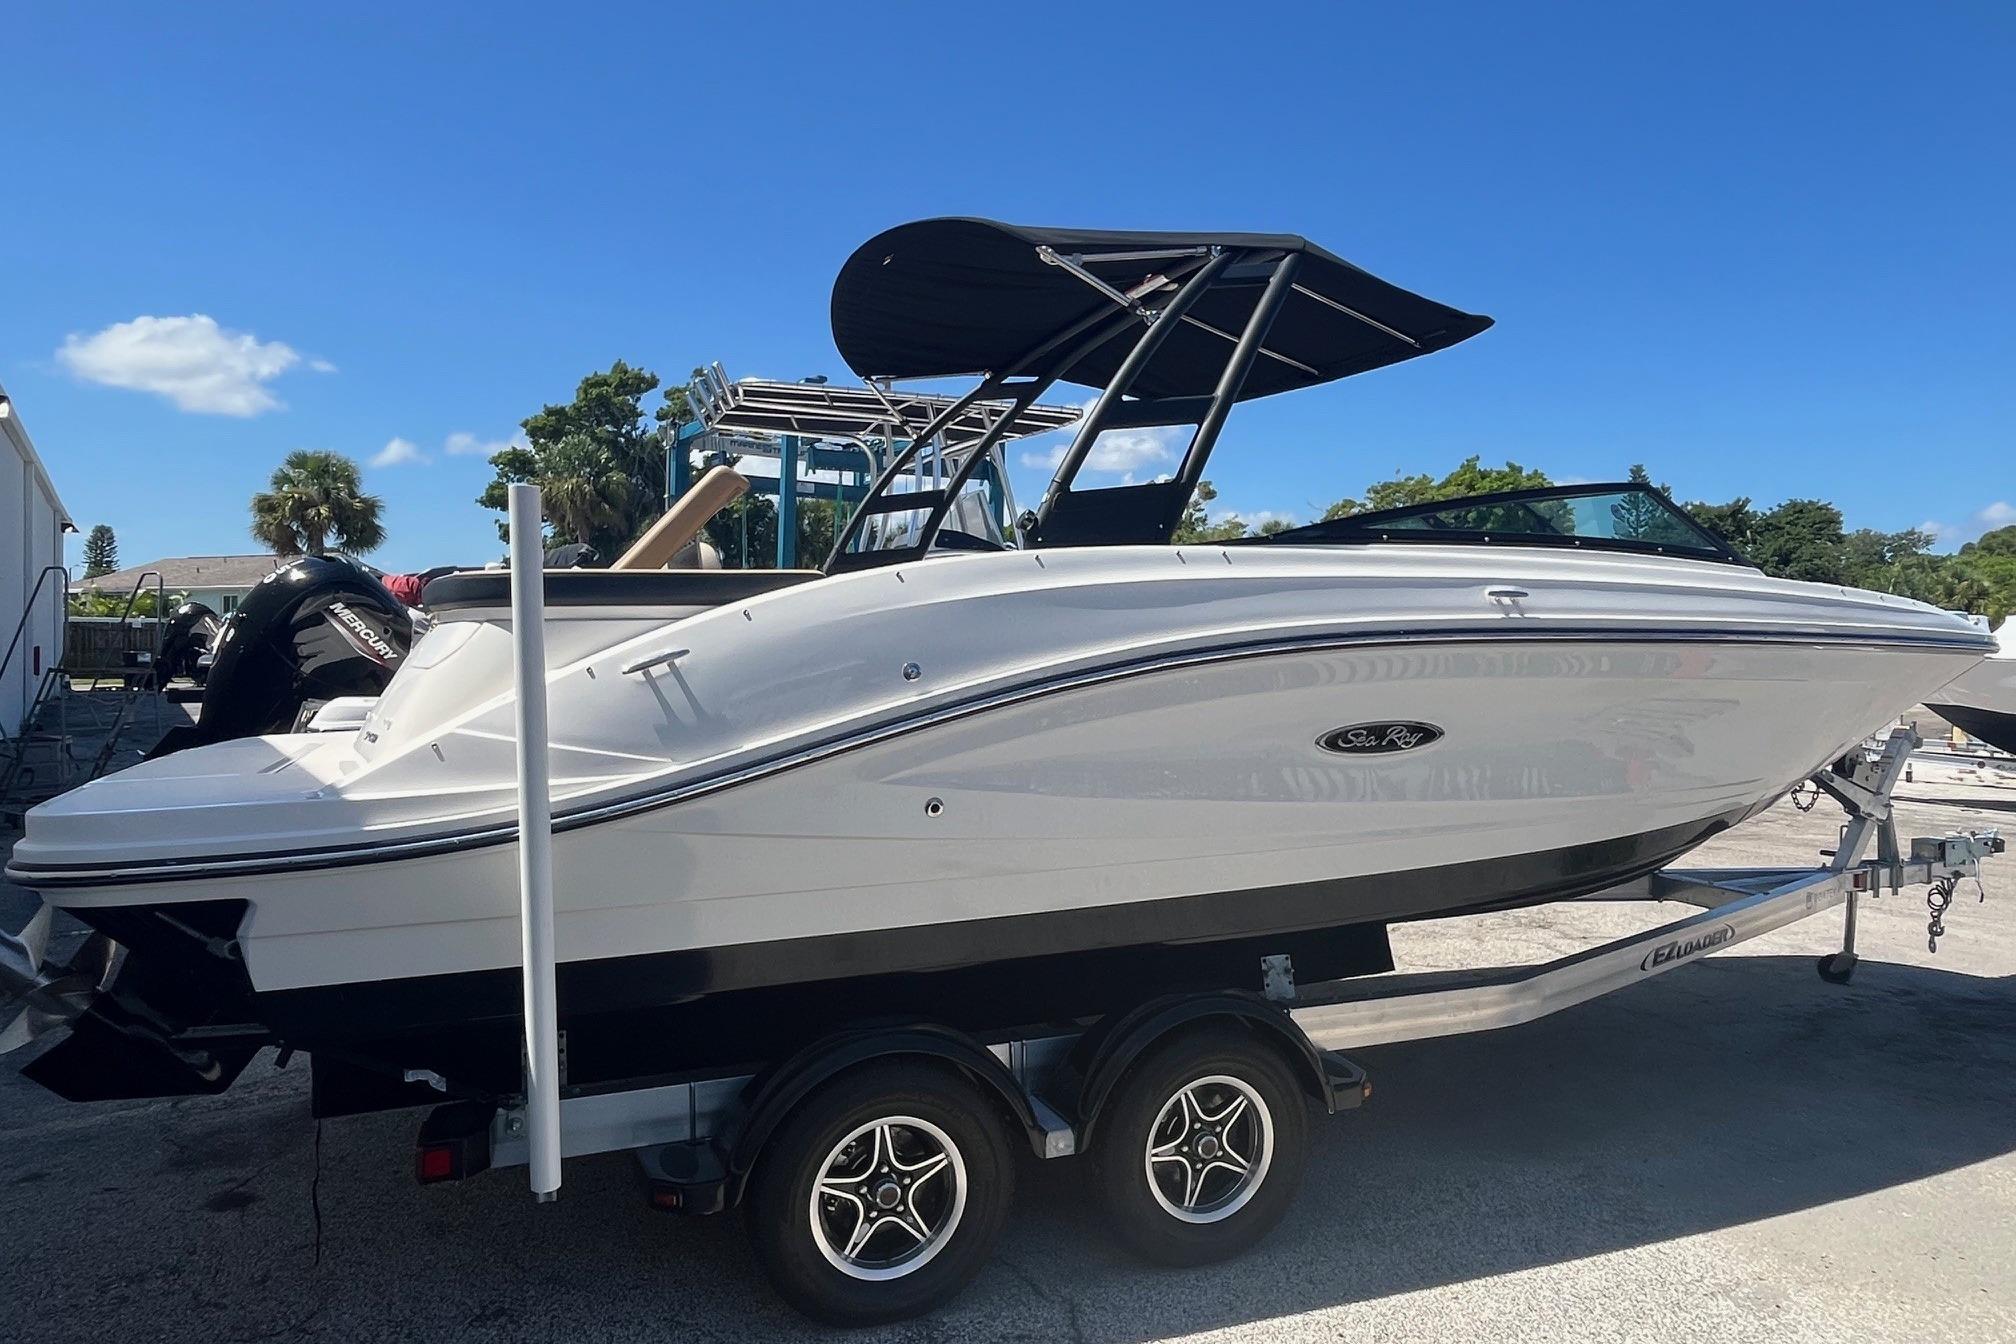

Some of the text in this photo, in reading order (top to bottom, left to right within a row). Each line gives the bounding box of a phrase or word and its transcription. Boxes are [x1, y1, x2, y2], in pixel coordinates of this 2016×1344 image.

[329, 601, 398, 660] MERCURY
[1338, 725, 1424, 749] Sea Ray
